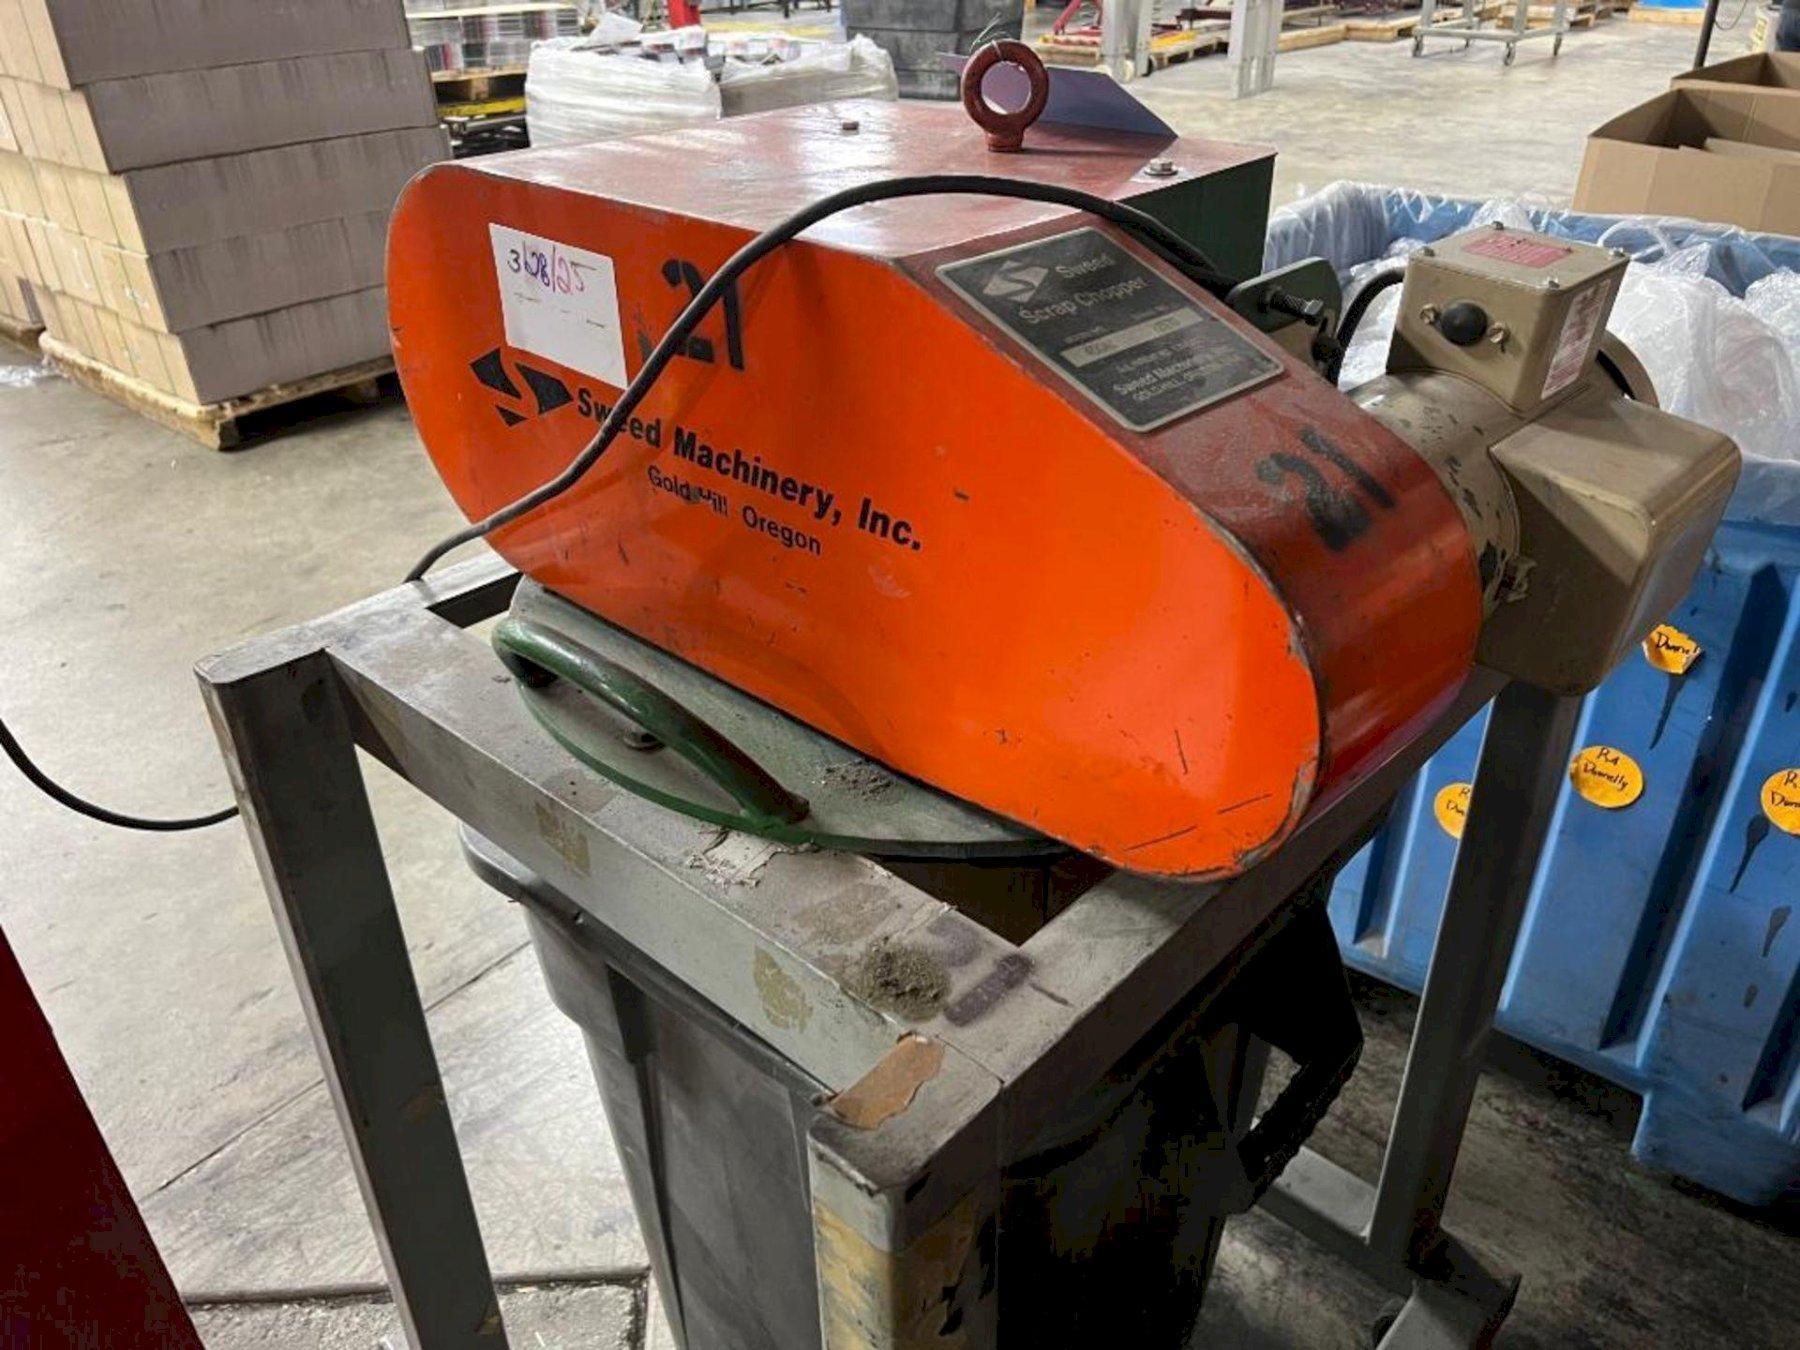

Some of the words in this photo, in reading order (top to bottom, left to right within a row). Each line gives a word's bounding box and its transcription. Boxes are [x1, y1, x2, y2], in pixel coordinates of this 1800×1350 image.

[1019, 299, 1077, 324] Scrap
[578, 387, 661, 448] Swed
[673, 426, 842, 526] Machinery,
[857, 497, 922, 551] Inc.
[648, 464, 691, 502] Gold
[741, 505, 822, 556] Oregon
[1254, 424, 1396, 554] 21
